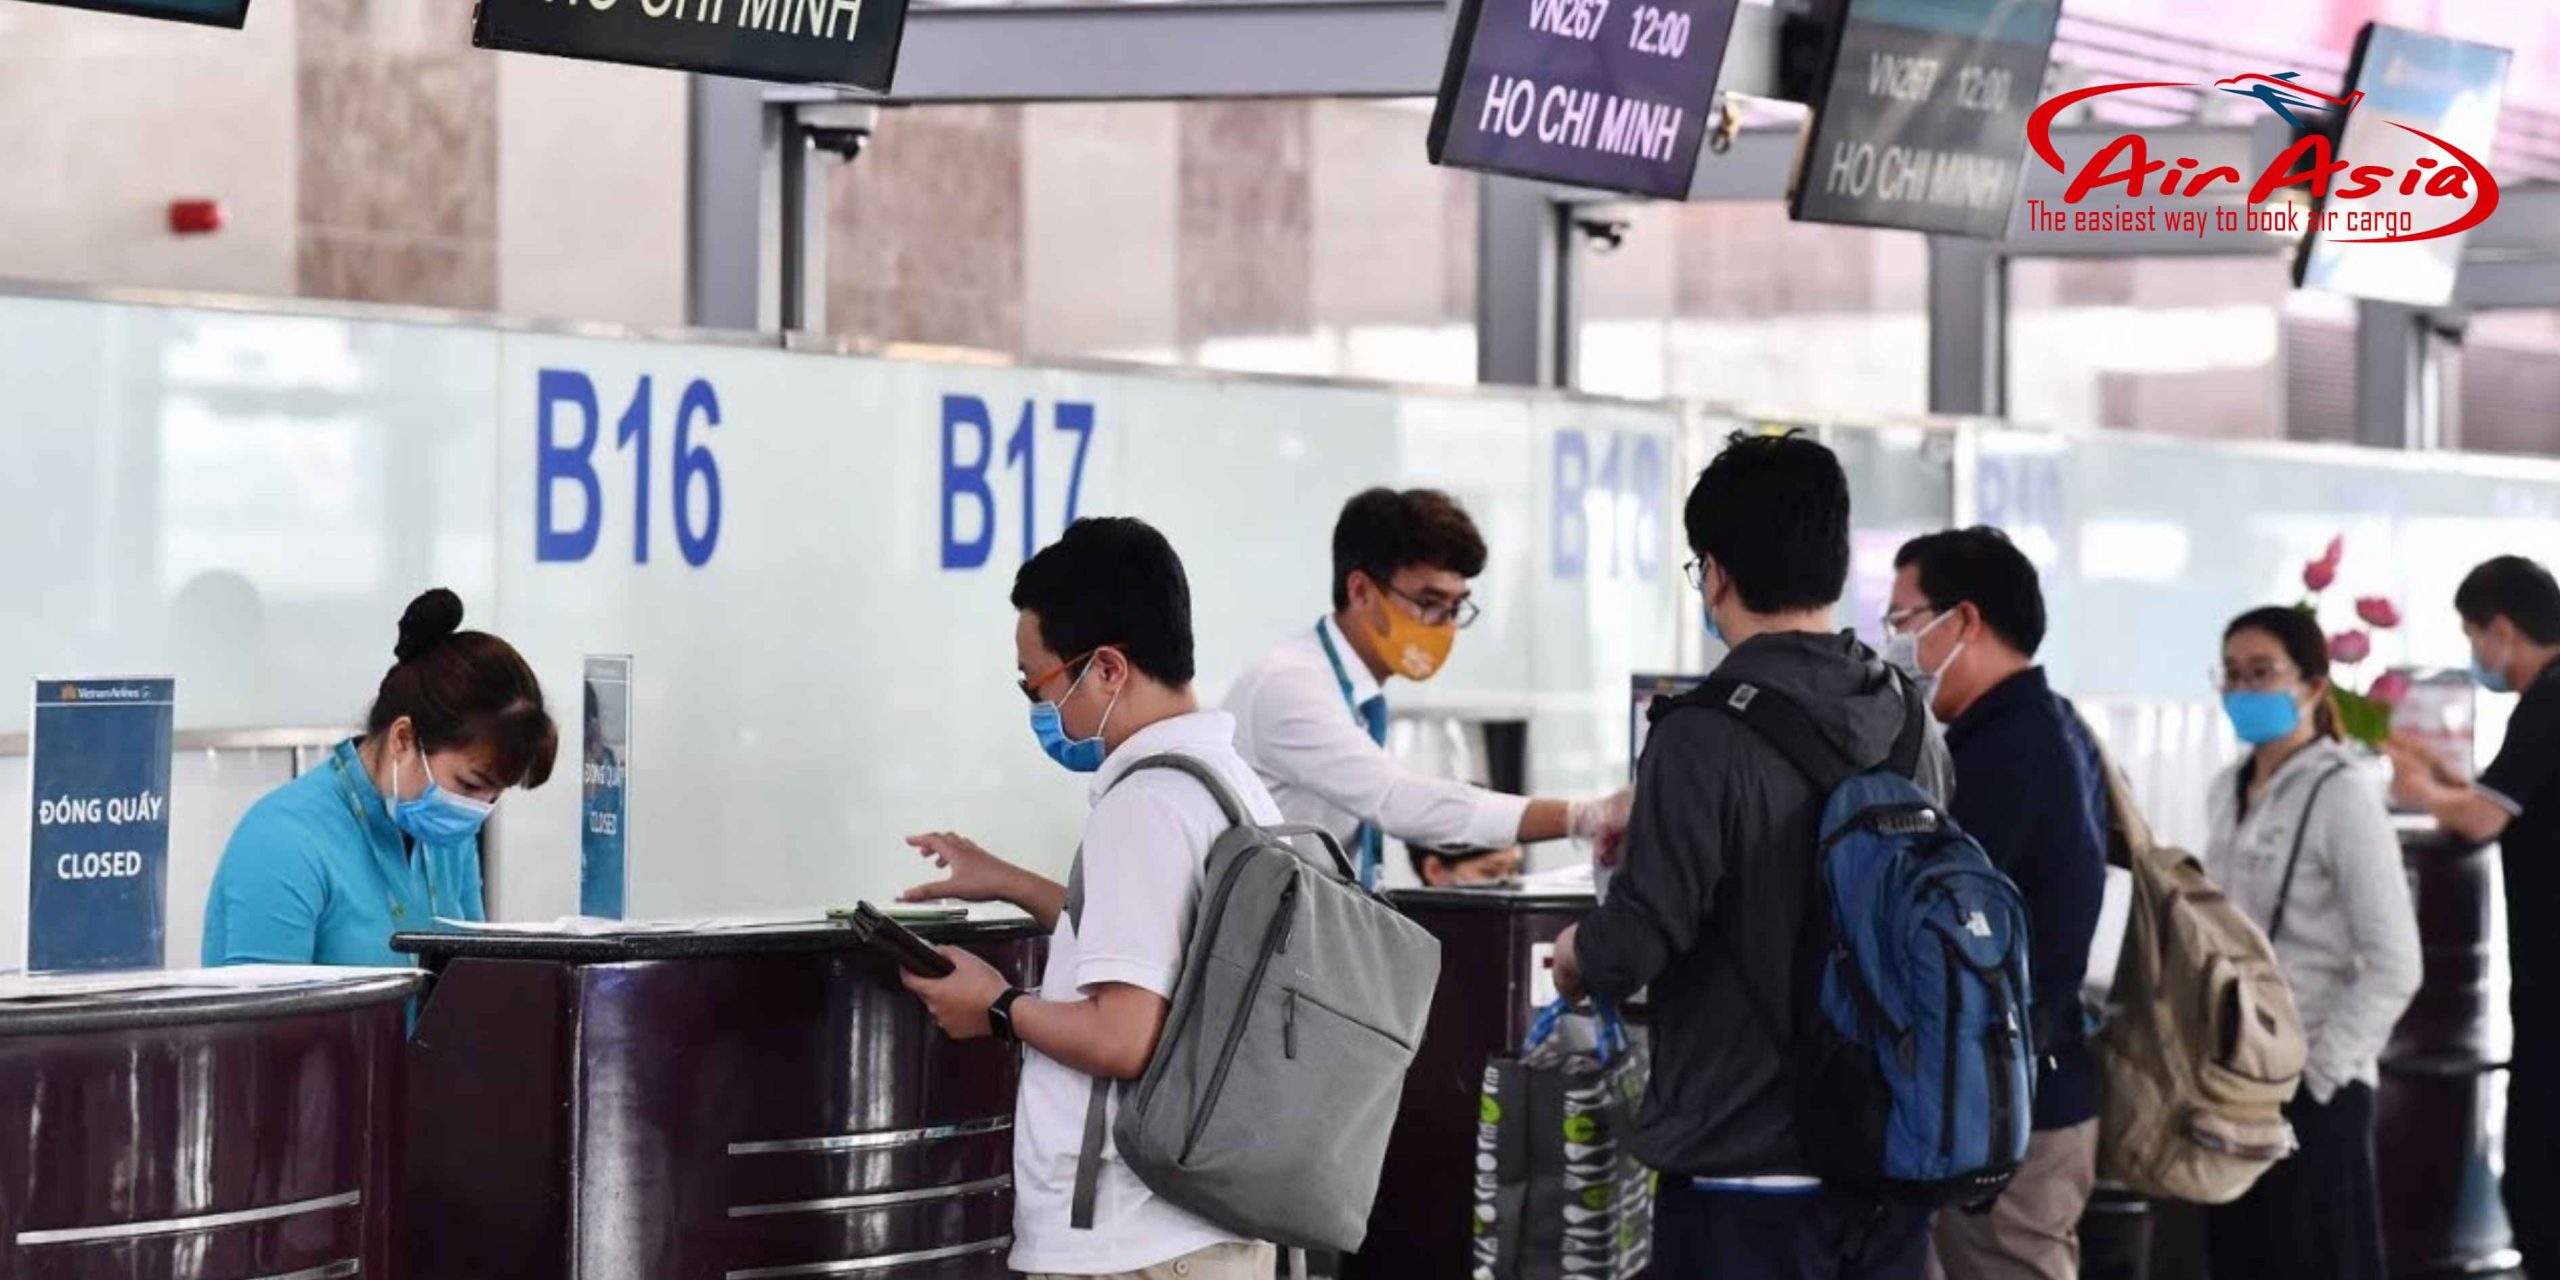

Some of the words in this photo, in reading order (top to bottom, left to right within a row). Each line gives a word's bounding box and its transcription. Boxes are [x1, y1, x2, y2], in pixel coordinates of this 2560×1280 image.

[1529, 0, 1610, 41] VN267
[1629, 4, 1691, 58] 12:00
[1479, 74, 1536, 138] HO
[1537, 84, 1600, 148] CHI
[1596, 95, 1683, 162] MINH
[1826, 141, 1876, 197] HO
[1877, 146, 1932, 201] CHI
[536, 368, 721, 568] B16
[941, 394, 1095, 570] B17
[39, 794, 101, 825] ĐÓNG
[57, 851, 141, 879] CLOSED
